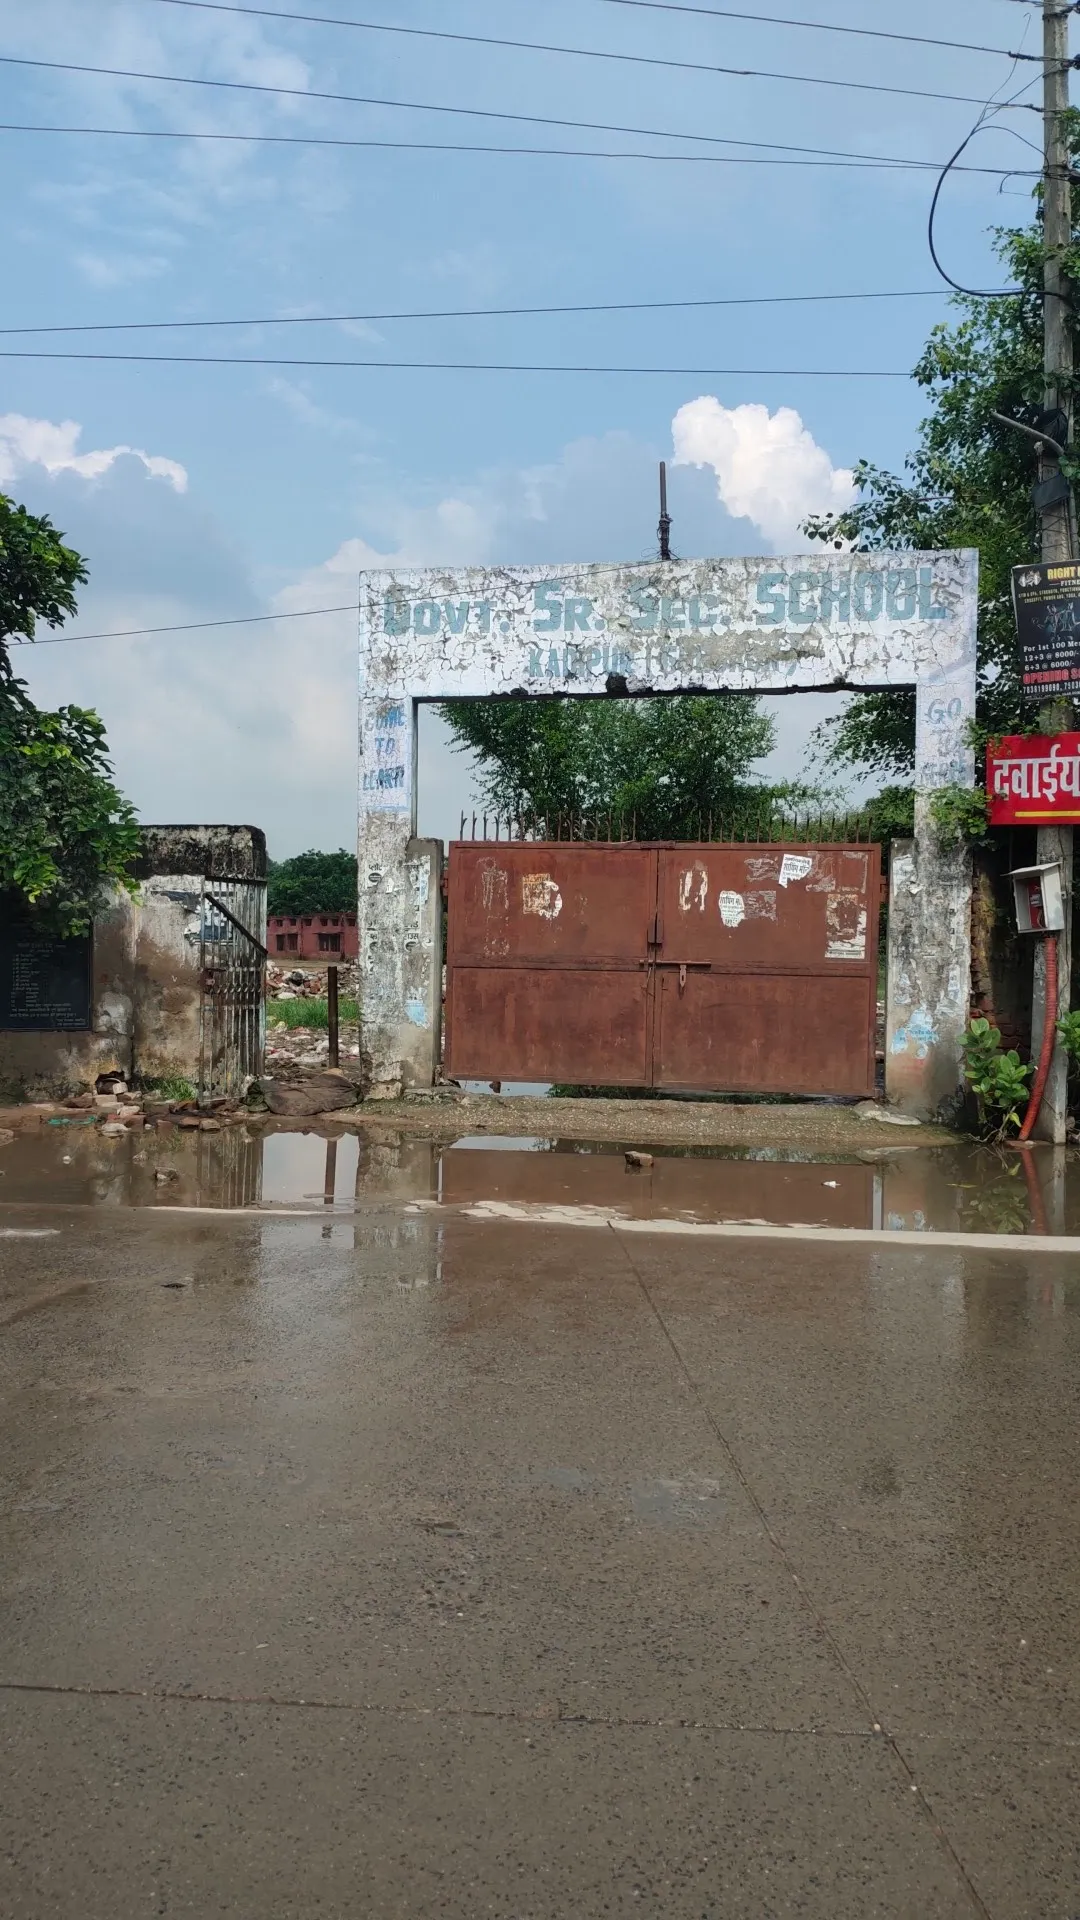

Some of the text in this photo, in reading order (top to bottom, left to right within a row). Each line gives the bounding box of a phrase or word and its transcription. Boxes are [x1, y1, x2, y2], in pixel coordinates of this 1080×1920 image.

[1047, 566, 1076, 580] RIGHT
[533, 580, 606, 632] SR.
[627, 578, 732, 631] SEC.
[755, 567, 947, 626] SCHOOL
[1023, 645, 1036, 653] For
[1038, 643, 1050, 651] 1st
[1051, 641, 1066, 649] 100
[1024, 653, 1044, 662] 12+3
[1054, 650, 1079, 659] 8000/-
[1024, 663, 1040, 671] 6+3
[1050, 660, 1075, 668] 6000/-
[1023, 668, 1069, 685] OPENING
[927, 697, 962, 724] GO
[374, 737, 396, 756] TO
[362, 765, 405, 791] LEARN
